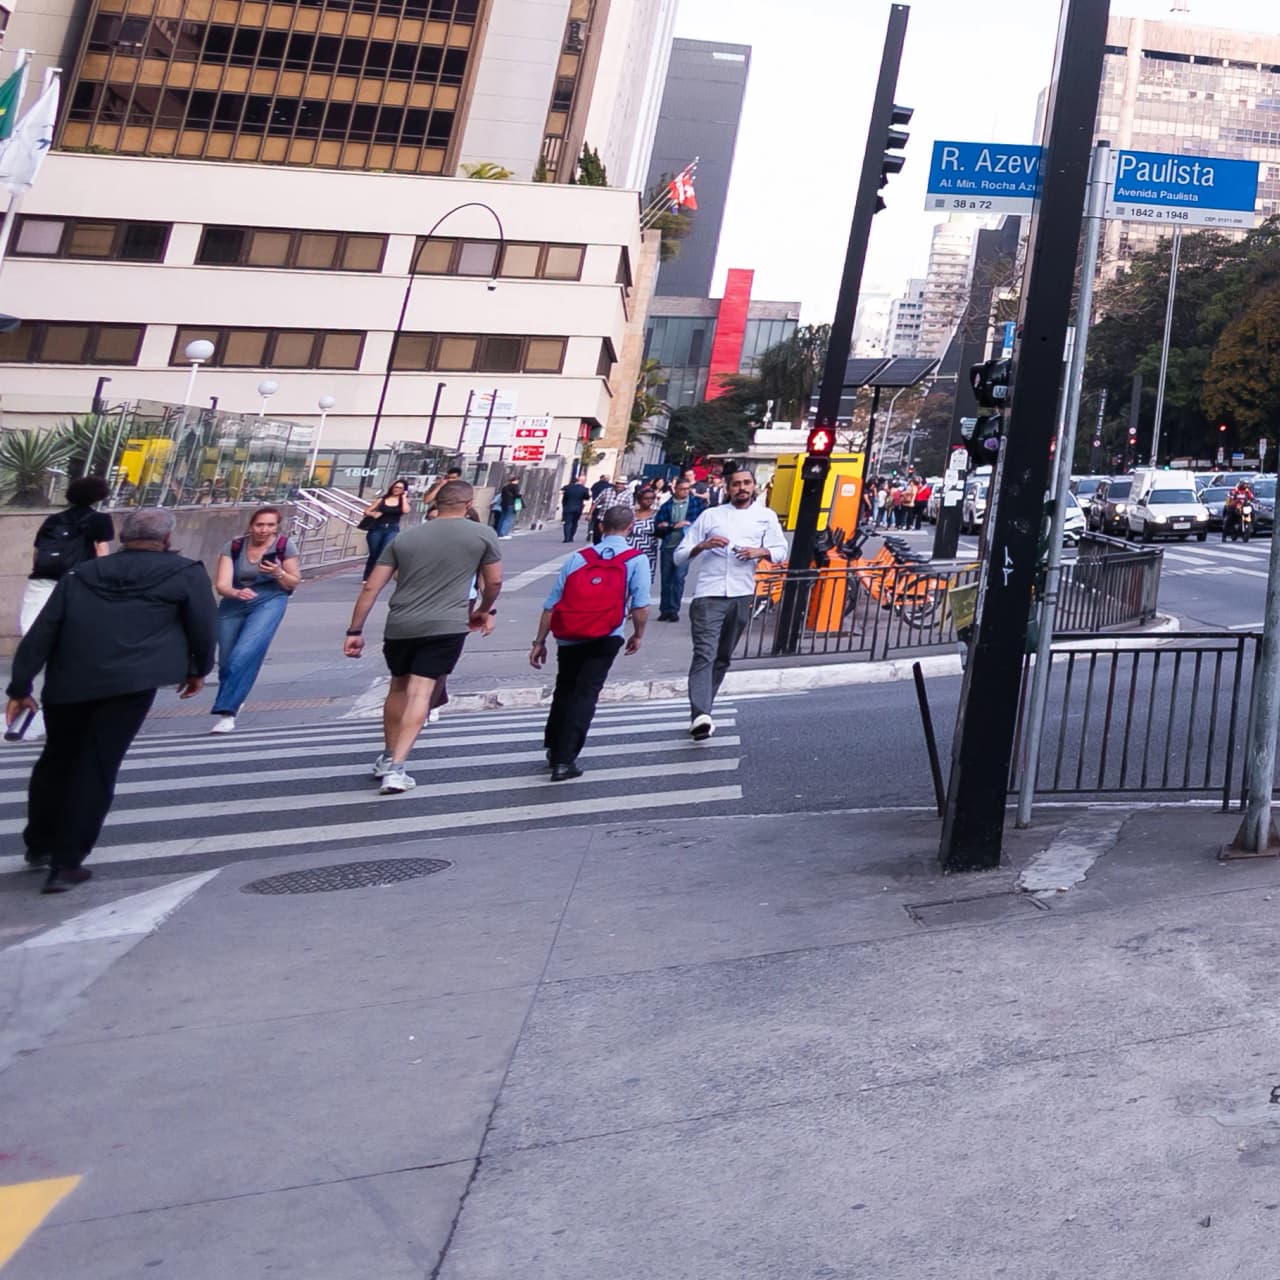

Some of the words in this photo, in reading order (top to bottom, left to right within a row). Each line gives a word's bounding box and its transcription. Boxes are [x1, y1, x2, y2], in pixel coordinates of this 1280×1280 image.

[941, 147, 965, 171] R.
[974, 148, 1039, 174] Azev
[1119, 155, 1215, 187] Paulista
[981, 180, 1016, 191] Rocha
[1117, 187, 1158, 199] Avenida
[1160, 190, 1199, 202] Paulista
[953, 199, 967, 209] 38
[969, 201, 976, 209] a
[979, 200, 992, 210] 72
[1130, 208, 1154, 218] 1842
[1166, 210, 1189, 220] 1948
[344, 467, 379, 477] 1804
